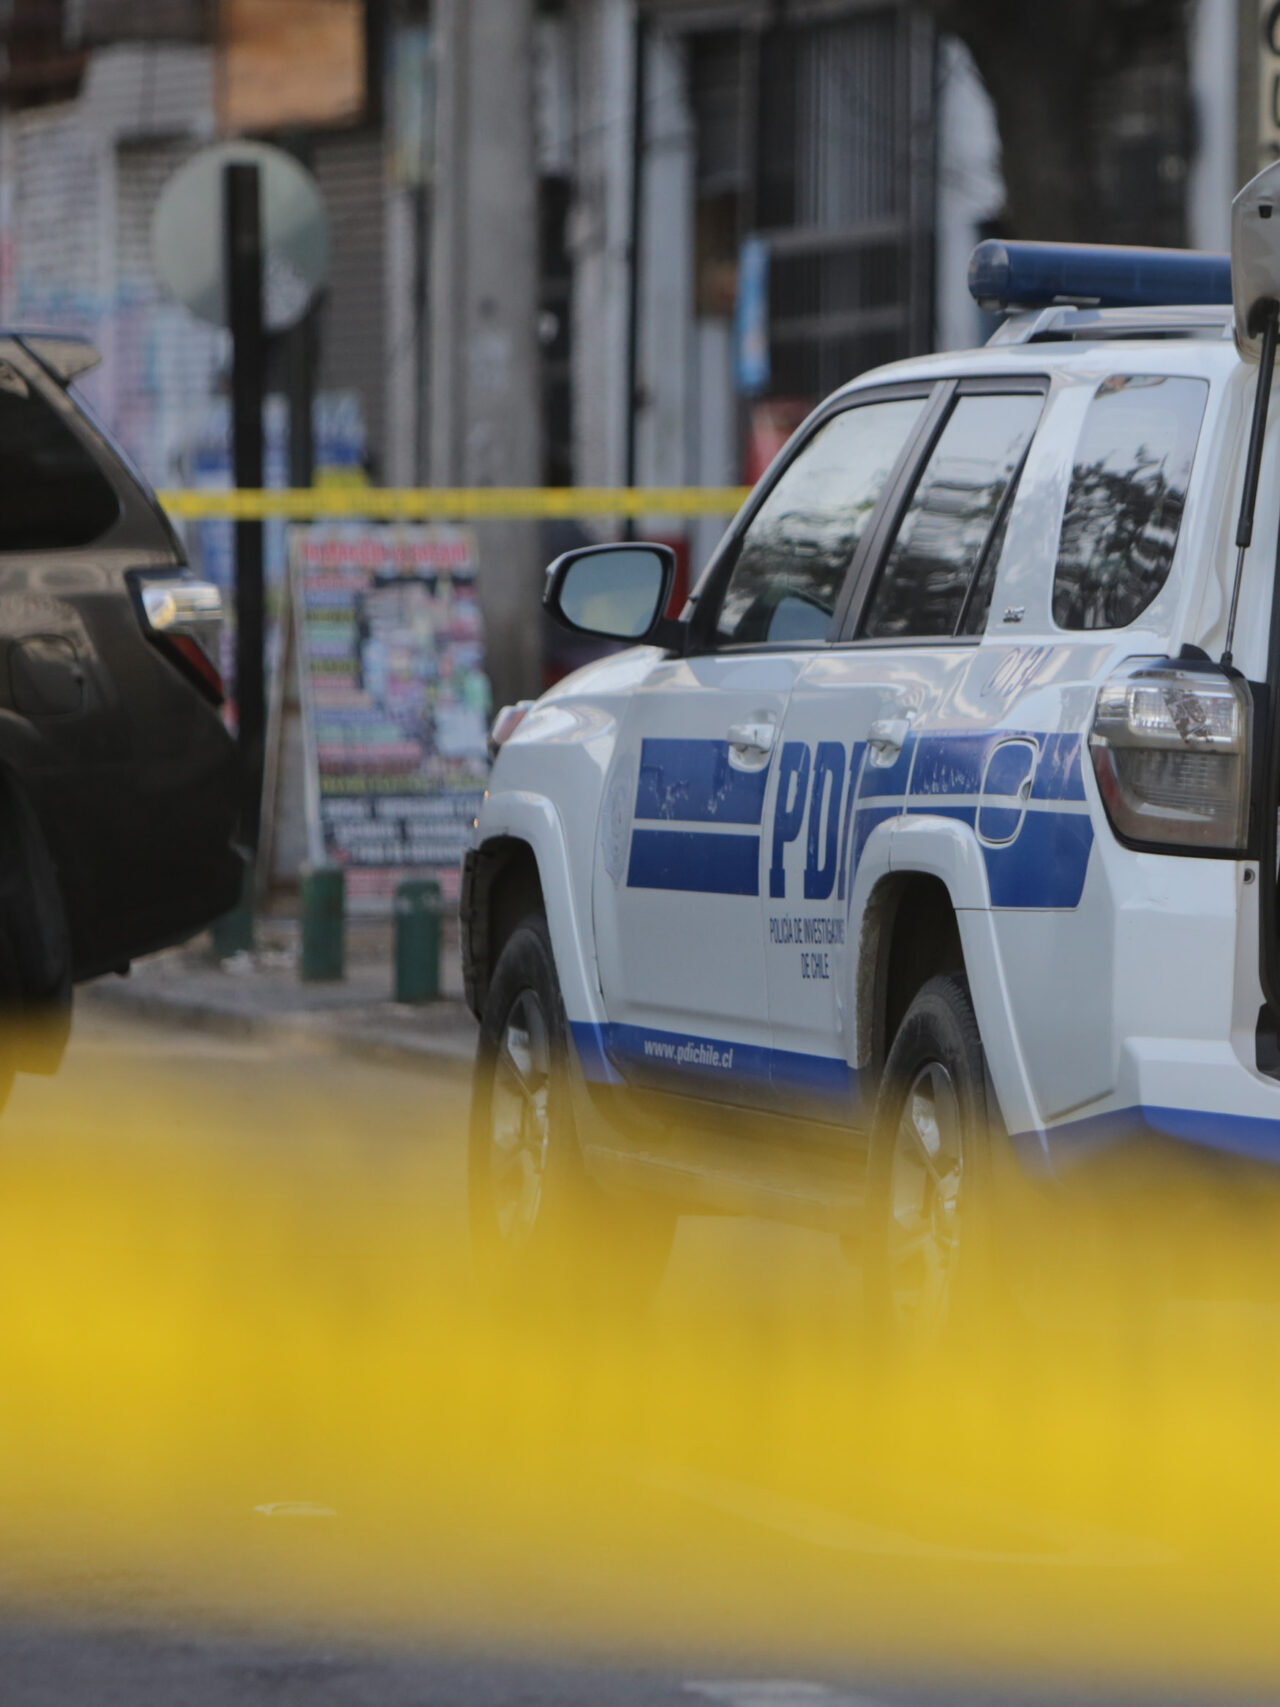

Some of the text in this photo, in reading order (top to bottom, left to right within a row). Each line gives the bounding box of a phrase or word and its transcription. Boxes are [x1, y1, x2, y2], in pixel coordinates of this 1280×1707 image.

[769, 741, 868, 901] PDI
[794, 918, 802, 944] DE
[801, 953, 829, 979] DE CHILE
[644, 1040, 734, 1069] www.pdichile.cl
